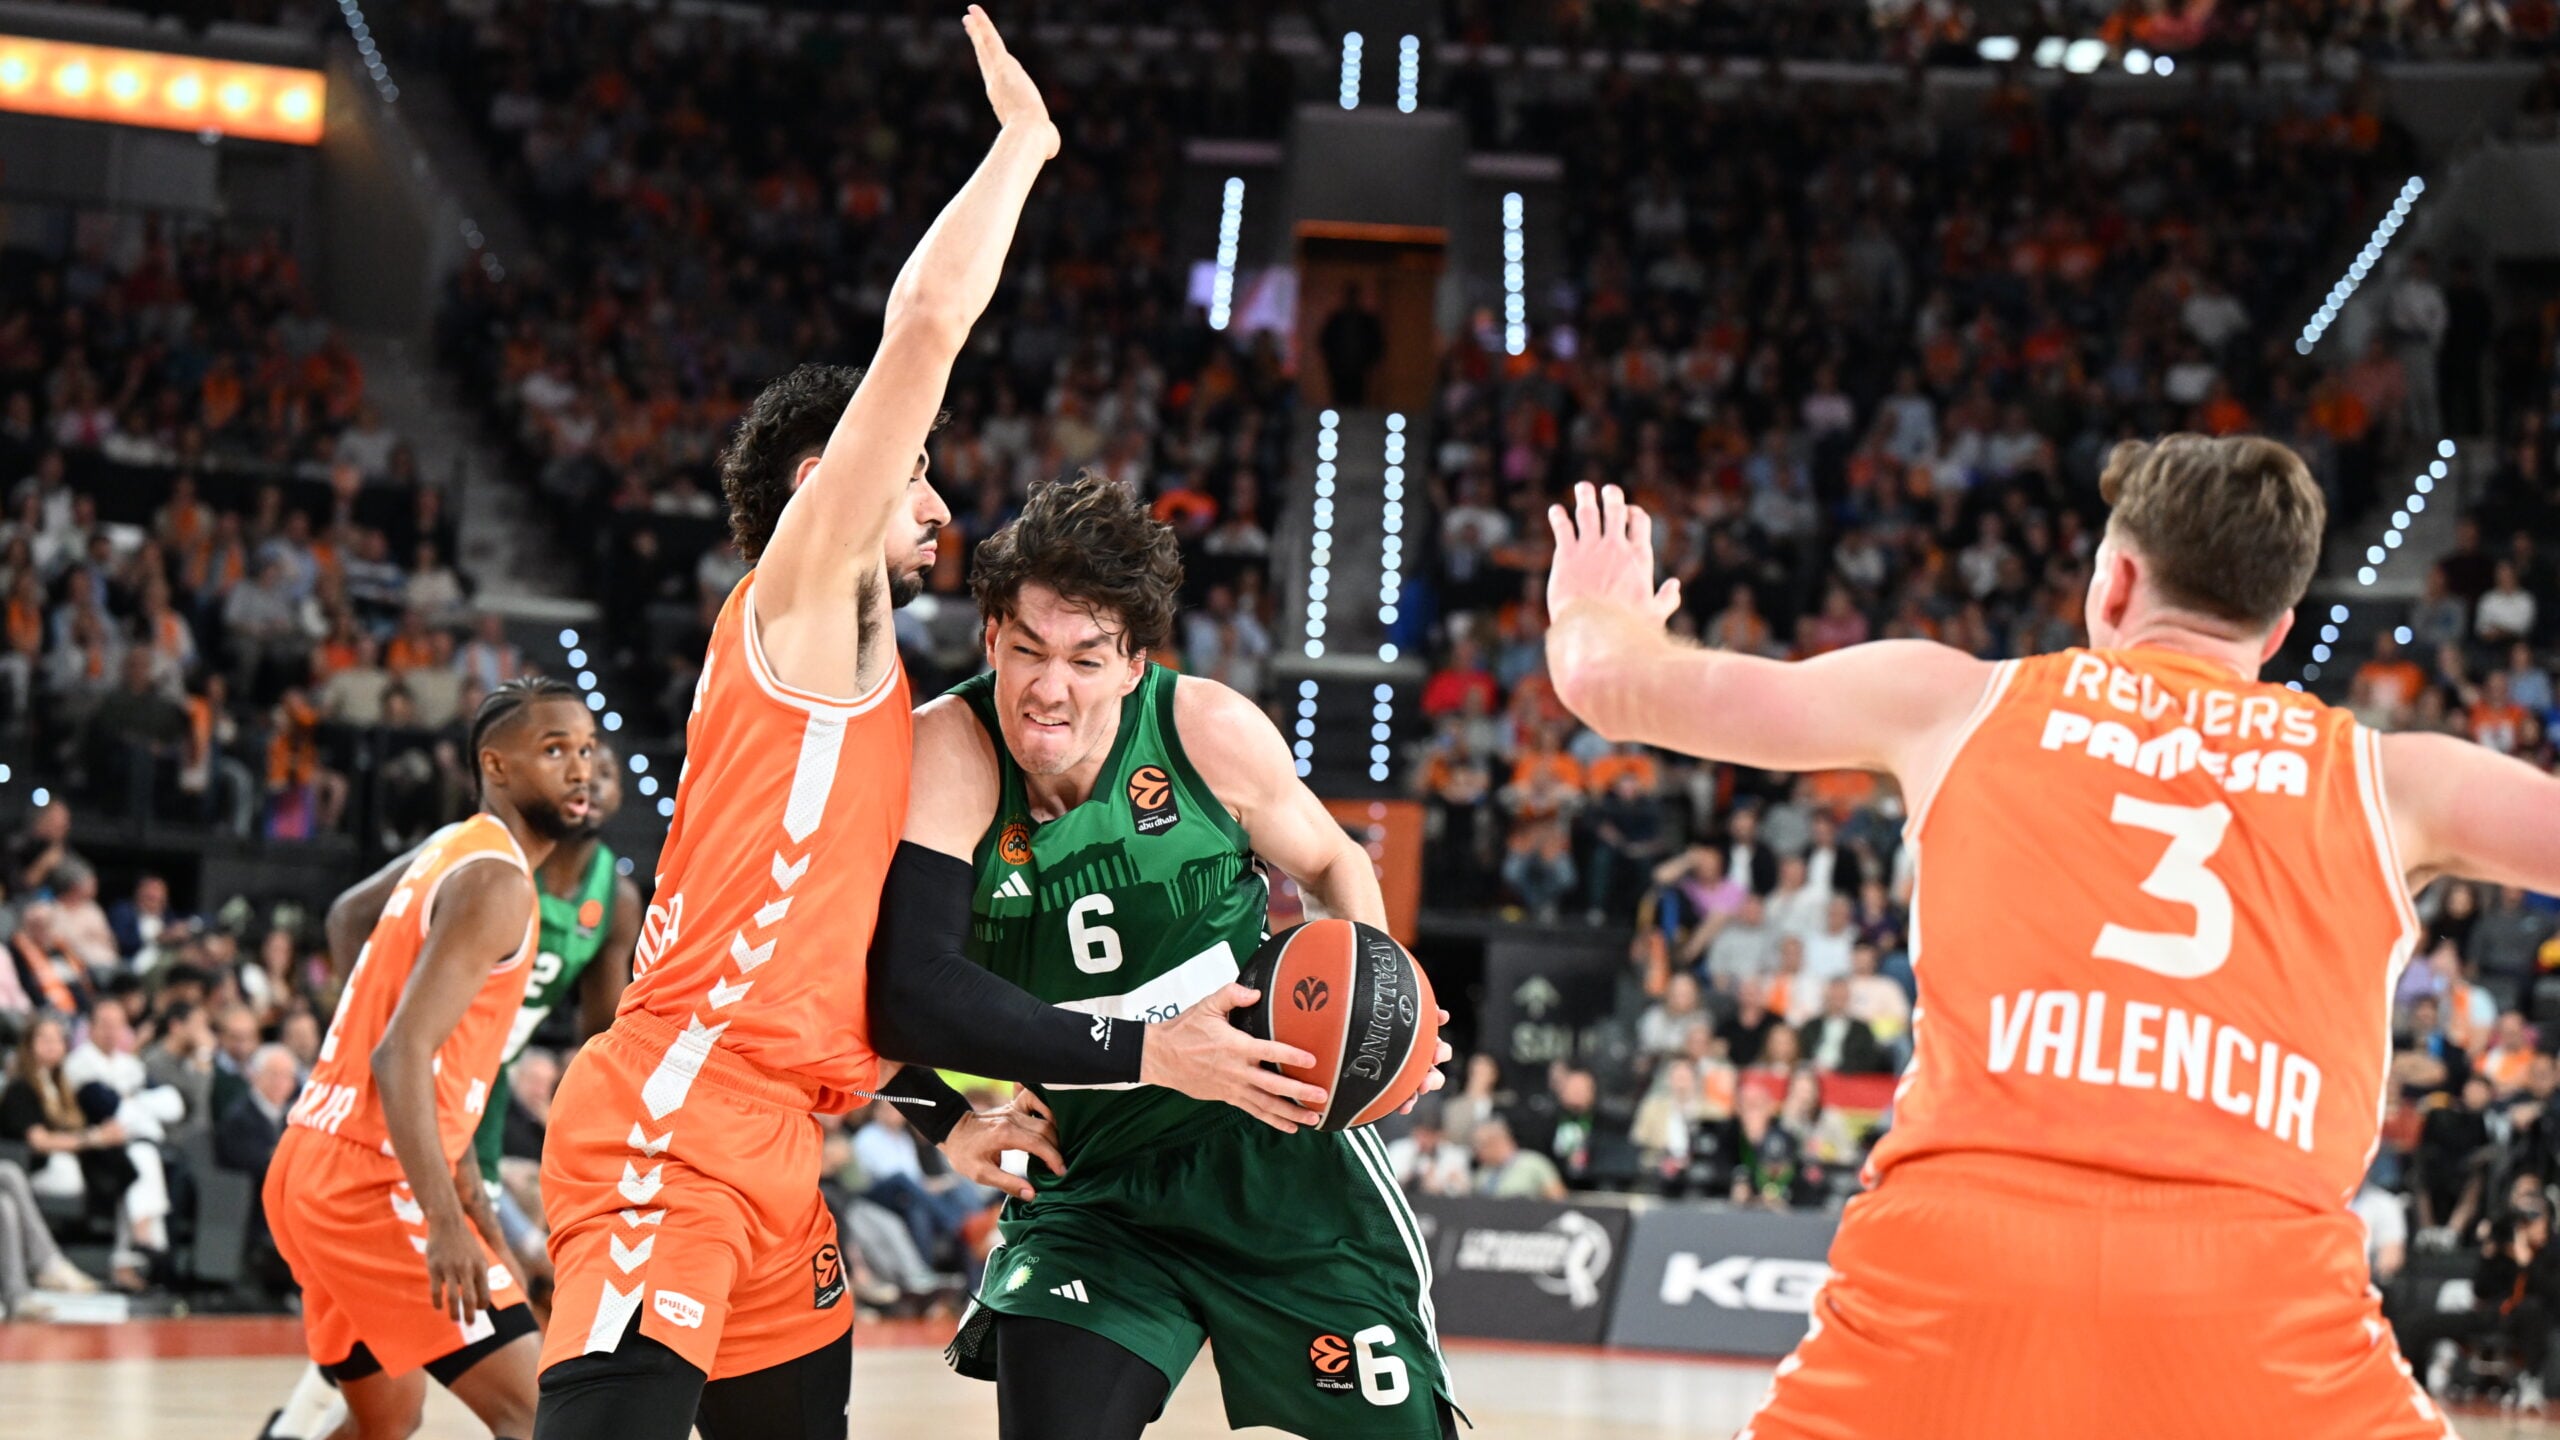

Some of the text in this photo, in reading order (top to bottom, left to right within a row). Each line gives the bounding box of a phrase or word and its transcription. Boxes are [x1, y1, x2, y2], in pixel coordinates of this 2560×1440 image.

[2040, 709, 2308, 796] PAMESA
[2091, 792, 2234, 979] 3
[1067, 893, 1123, 974] 6
[1348, 938, 1398, 1081] SPALDING
[1987, 989, 2321, 1152] VALENCIA
[1027, 1256, 1040, 1264] bp
[659, 1297, 699, 1320] PULEVA
[1353, 1324, 1410, 1406] 6
